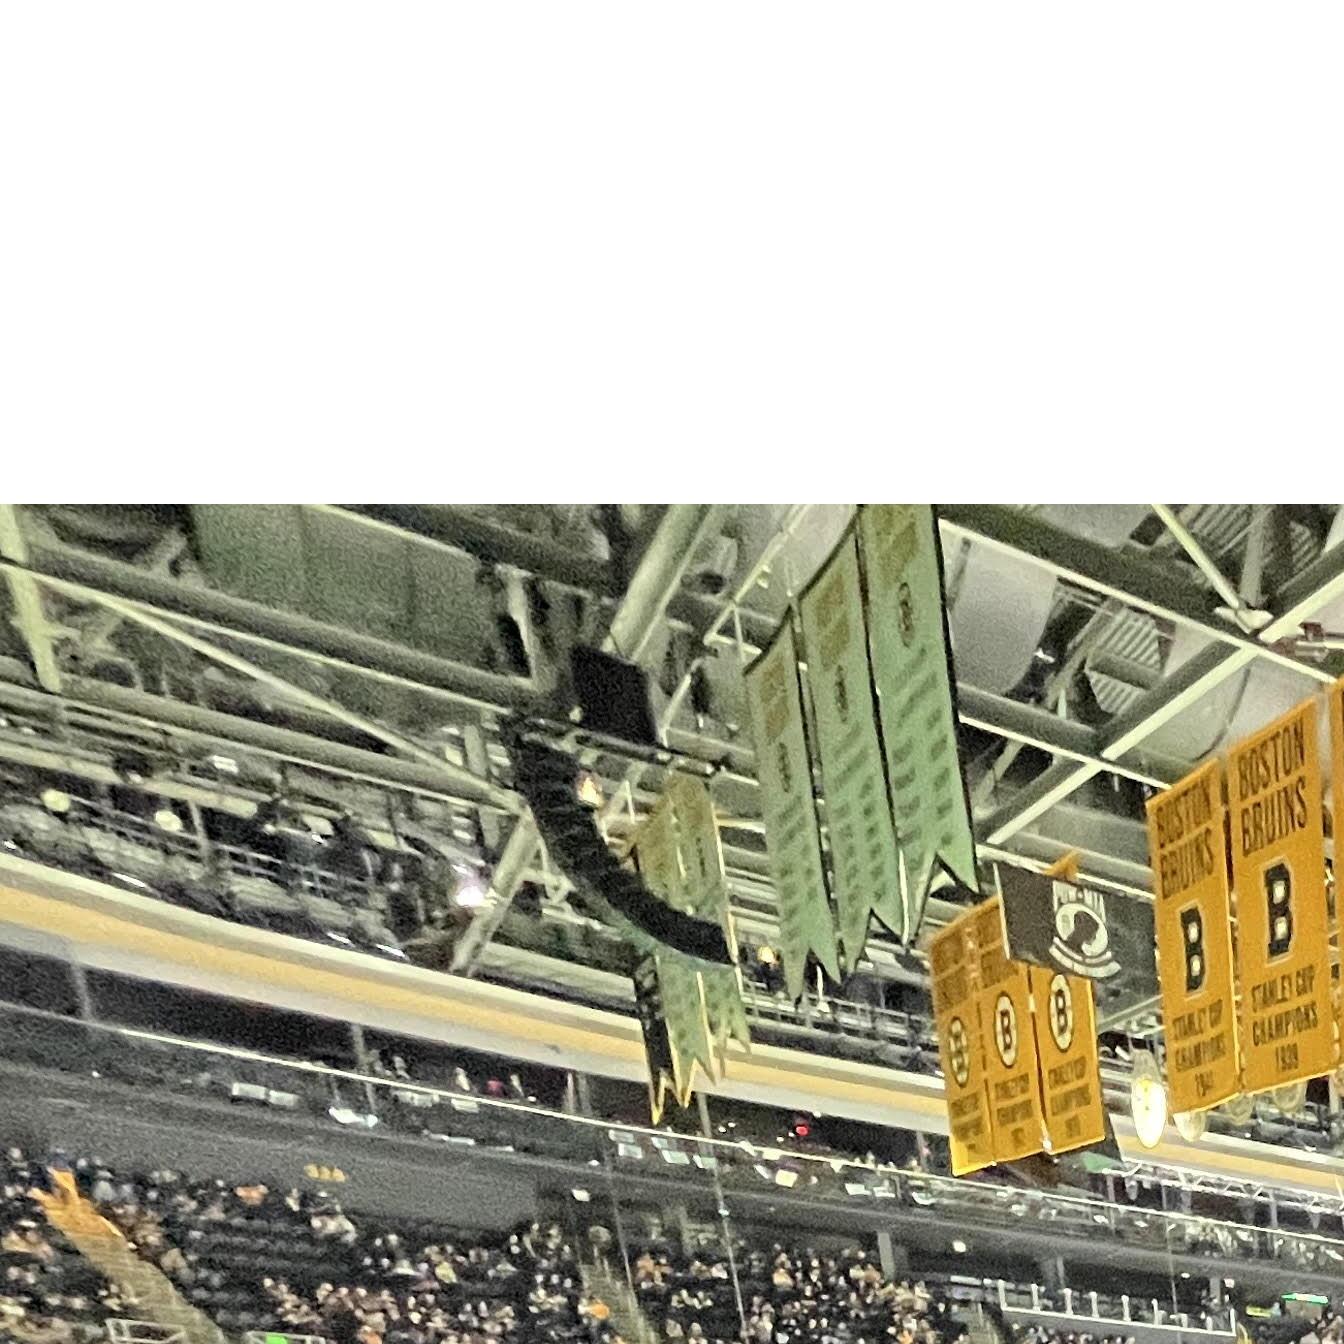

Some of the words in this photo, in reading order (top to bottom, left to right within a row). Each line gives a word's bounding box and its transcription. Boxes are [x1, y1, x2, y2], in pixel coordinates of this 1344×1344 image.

[1238, 717, 1304, 799] BOSTON
[1241, 776, 1307, 857] BRUINS
[1160, 828, 1214, 900] BRUINS
[1265, 863, 1292, 957] B
[1252, 974, 1292, 1013] STANLEY
[1253, 1001, 1318, 1047] CHAMPIONS
